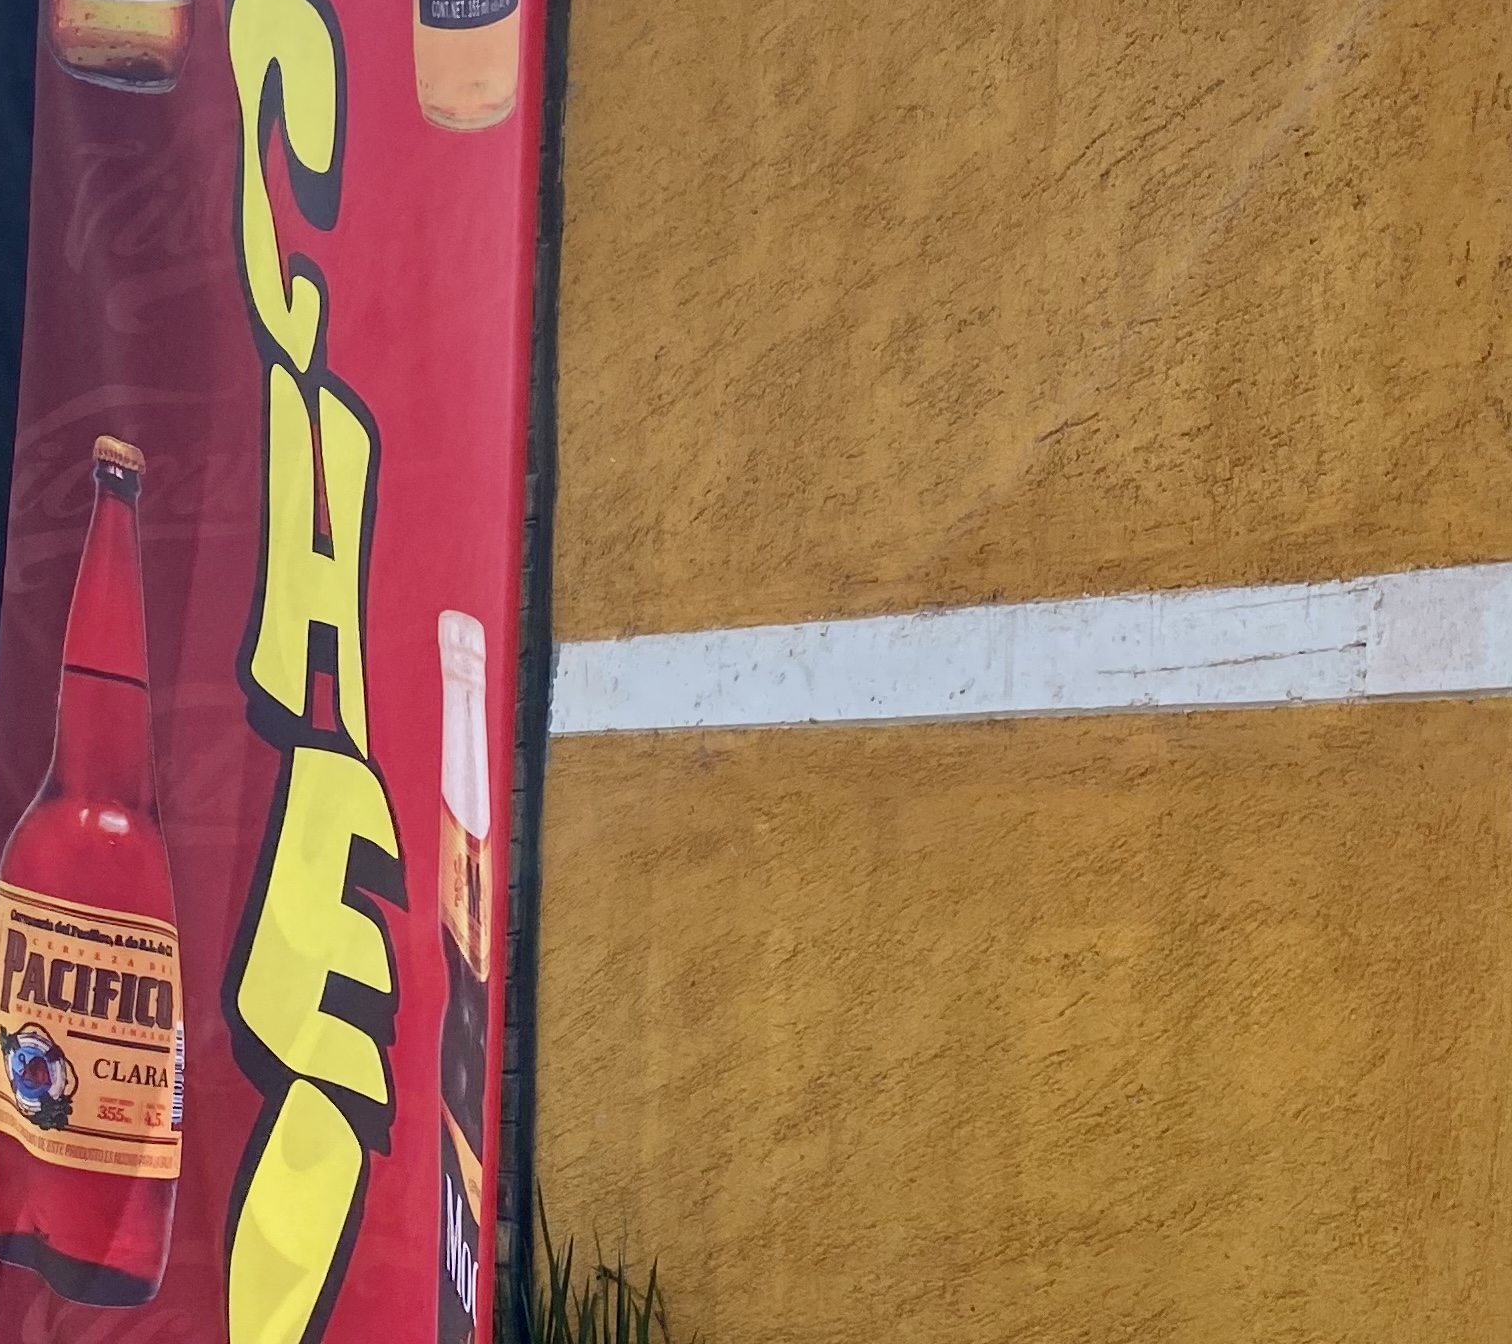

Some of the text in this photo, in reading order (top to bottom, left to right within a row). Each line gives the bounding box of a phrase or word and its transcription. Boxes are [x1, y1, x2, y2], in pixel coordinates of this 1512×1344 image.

[32, 937, 135, 968] CERVEZA
[0, 928, 174, 1031] PACIFICO
[92, 1058, 169, 1089] CLARA
